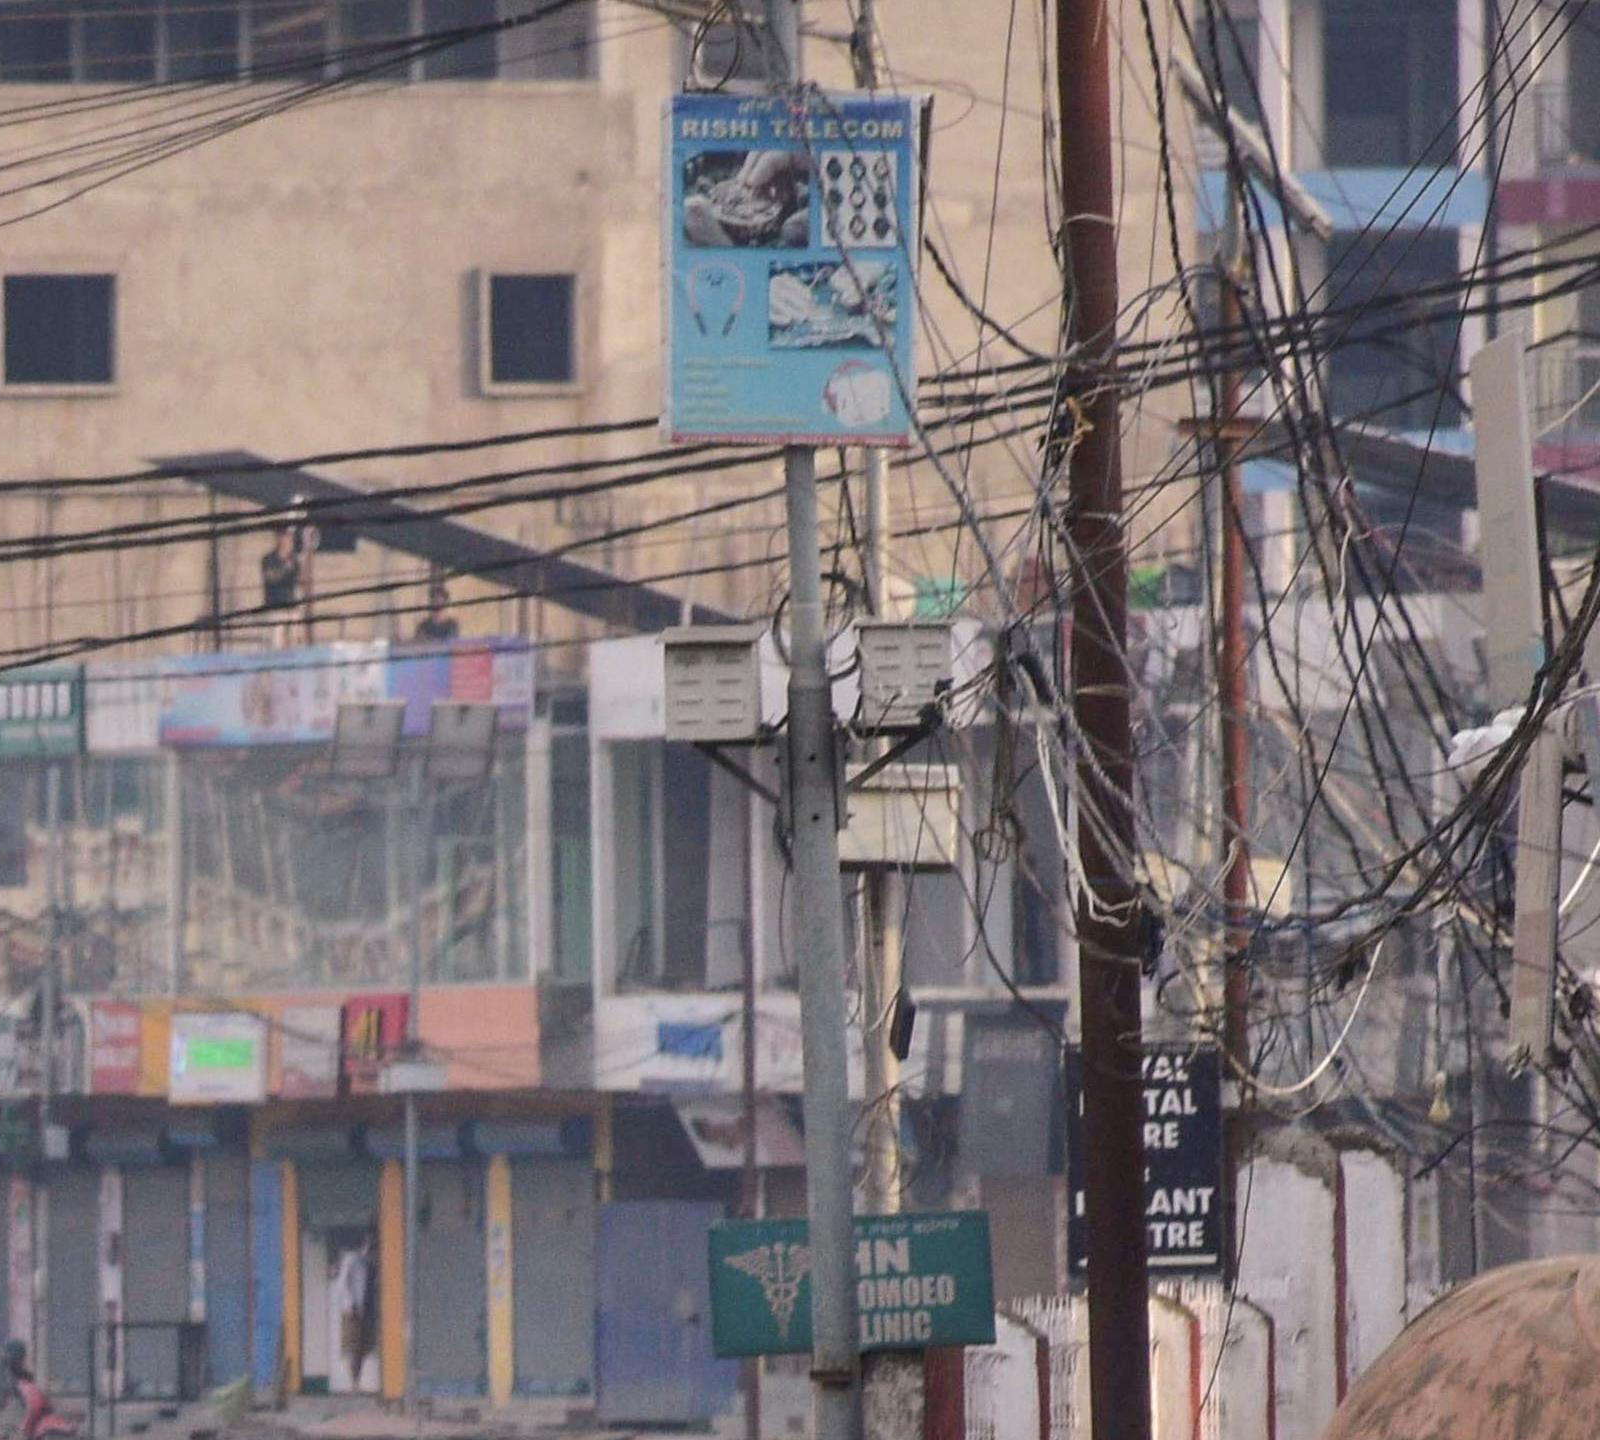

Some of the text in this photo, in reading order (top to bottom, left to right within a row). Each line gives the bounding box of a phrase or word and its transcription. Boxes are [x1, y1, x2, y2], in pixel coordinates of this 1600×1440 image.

[682, 118, 904, 140] RISHI TELECOM
[1143, 1121, 1180, 1150] RE
[1147, 1220, 1205, 1249] TRE
[857, 1274, 956, 1311] OMOEO
[859, 1310, 933, 1345] LINIC
